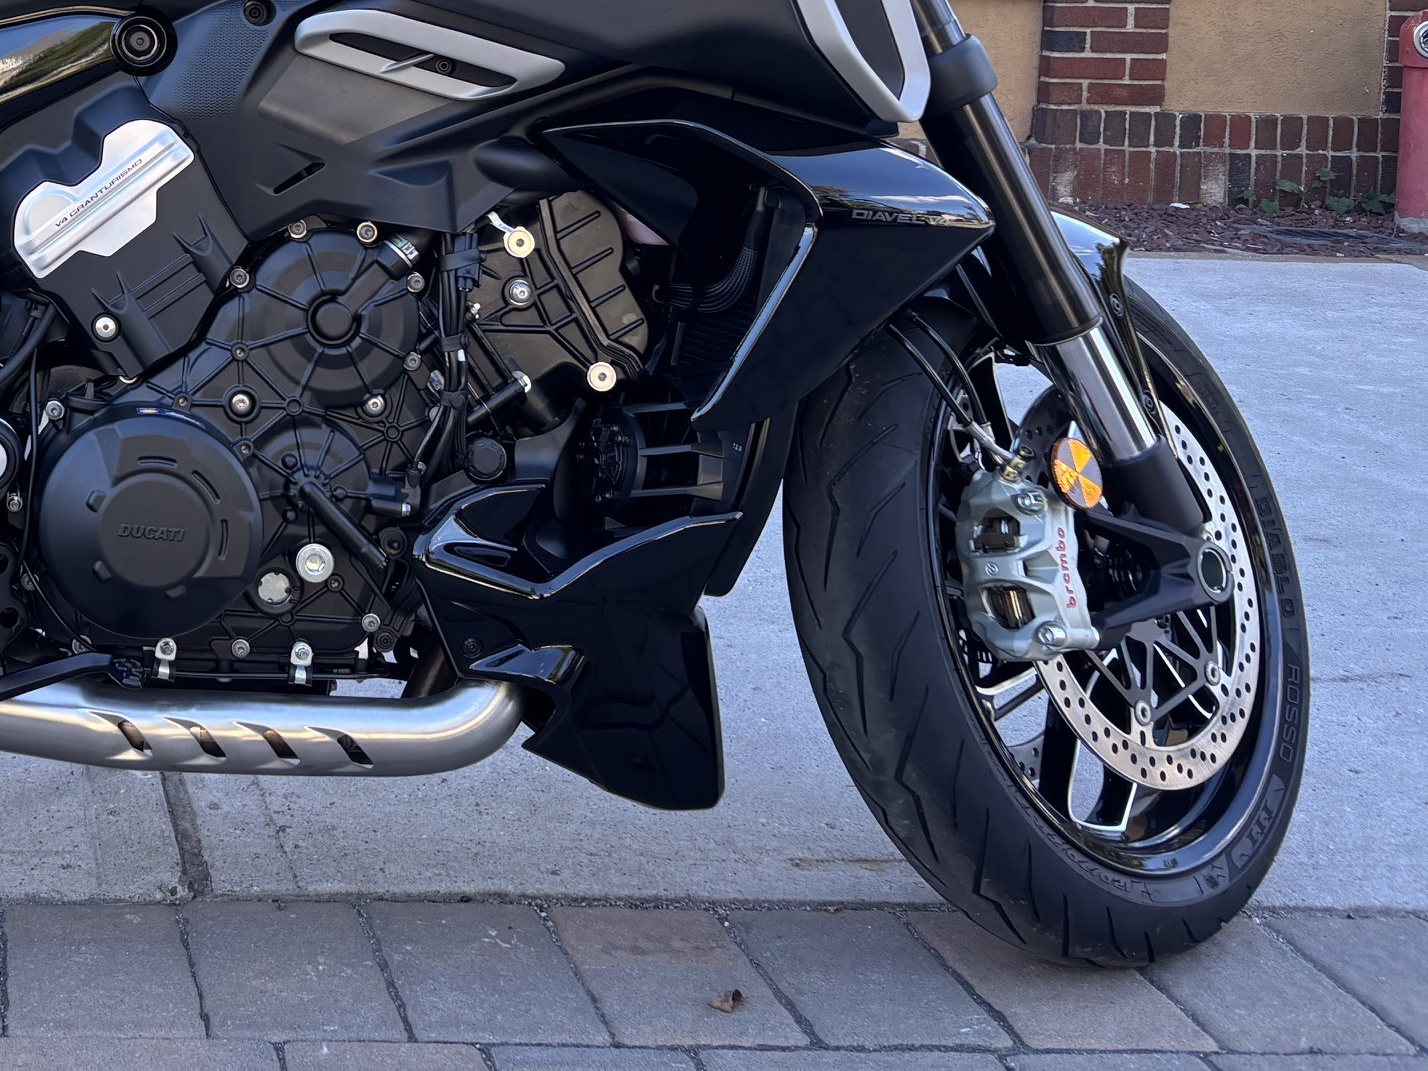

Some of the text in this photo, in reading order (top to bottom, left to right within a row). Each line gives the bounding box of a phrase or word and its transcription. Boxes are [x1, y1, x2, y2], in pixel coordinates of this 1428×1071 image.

[55, 158, 143, 228] V4 GRANTURISMO
[852, 209, 926, 225] DIAVEL
[118, 524, 186, 543] DUCATI
[1056, 527, 1077, 609] brembo
[1253, 496, 1293, 619] DIABLO
[1278, 662, 1300, 764] ROSSO
